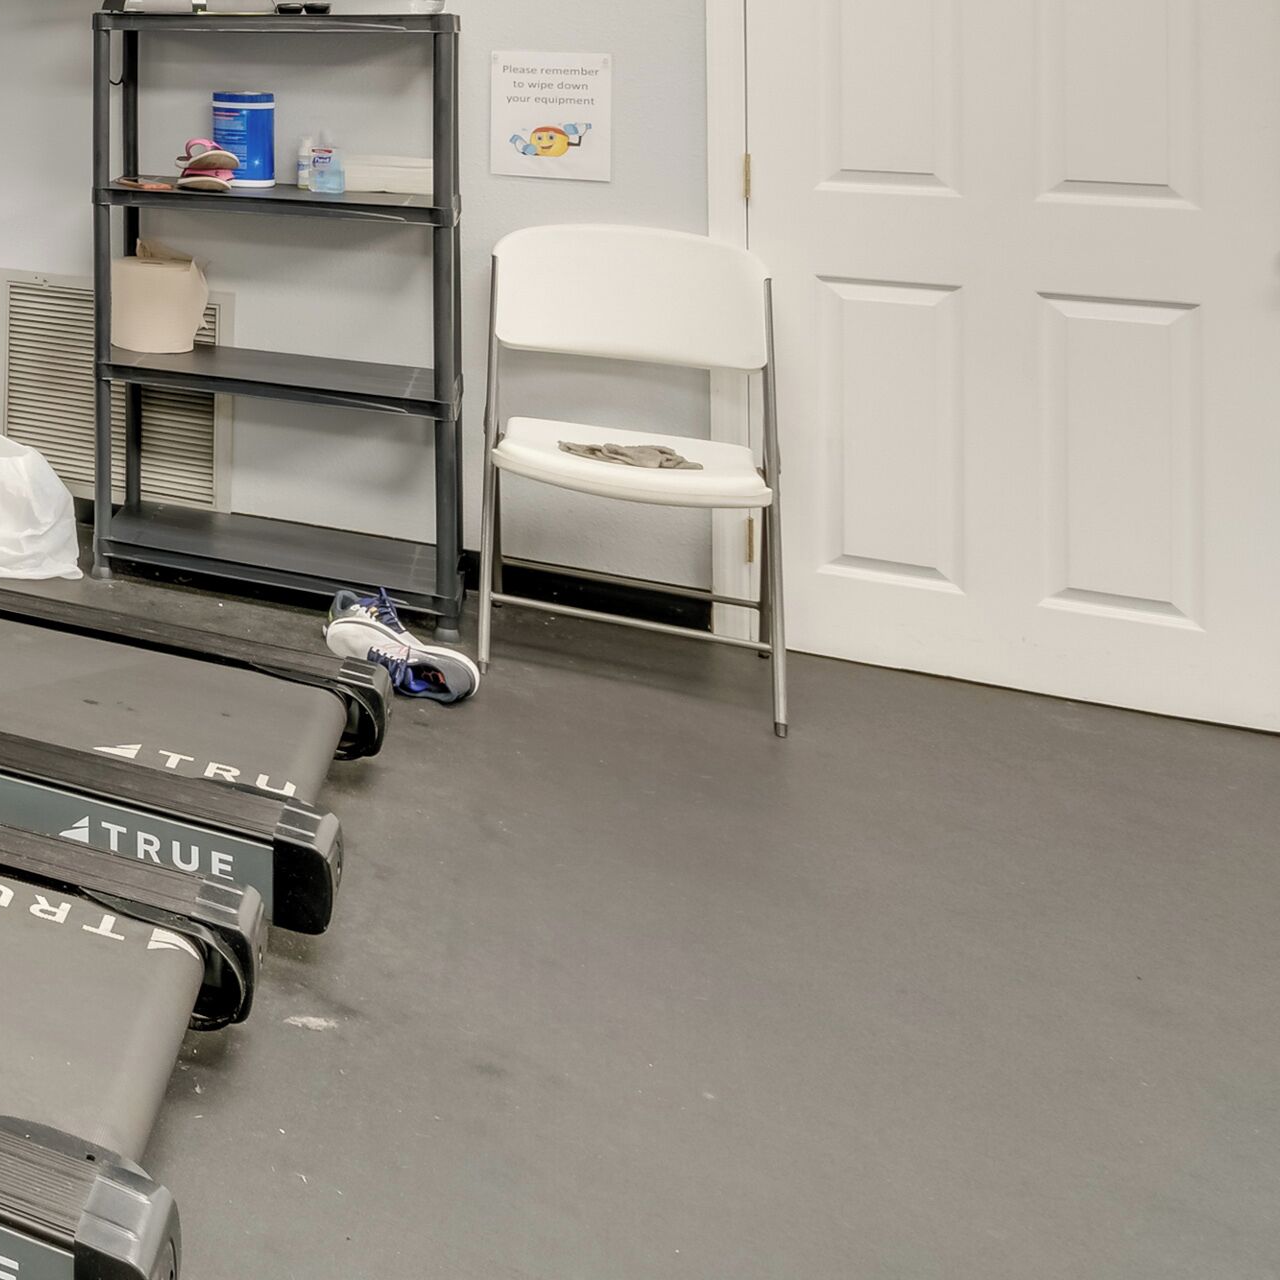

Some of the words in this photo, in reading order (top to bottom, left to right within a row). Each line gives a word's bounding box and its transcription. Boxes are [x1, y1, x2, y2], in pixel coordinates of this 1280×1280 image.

[502, 64, 538, 75] Please
[540, 66, 600, 77] remember
[513, 80, 525, 89] to
[527, 81, 554, 91] wipe
[556, 81, 589, 91] down
[506, 94, 531, 105] your
[534, 95, 595, 106] equipment
[100, 820, 235, 881] TRUE
